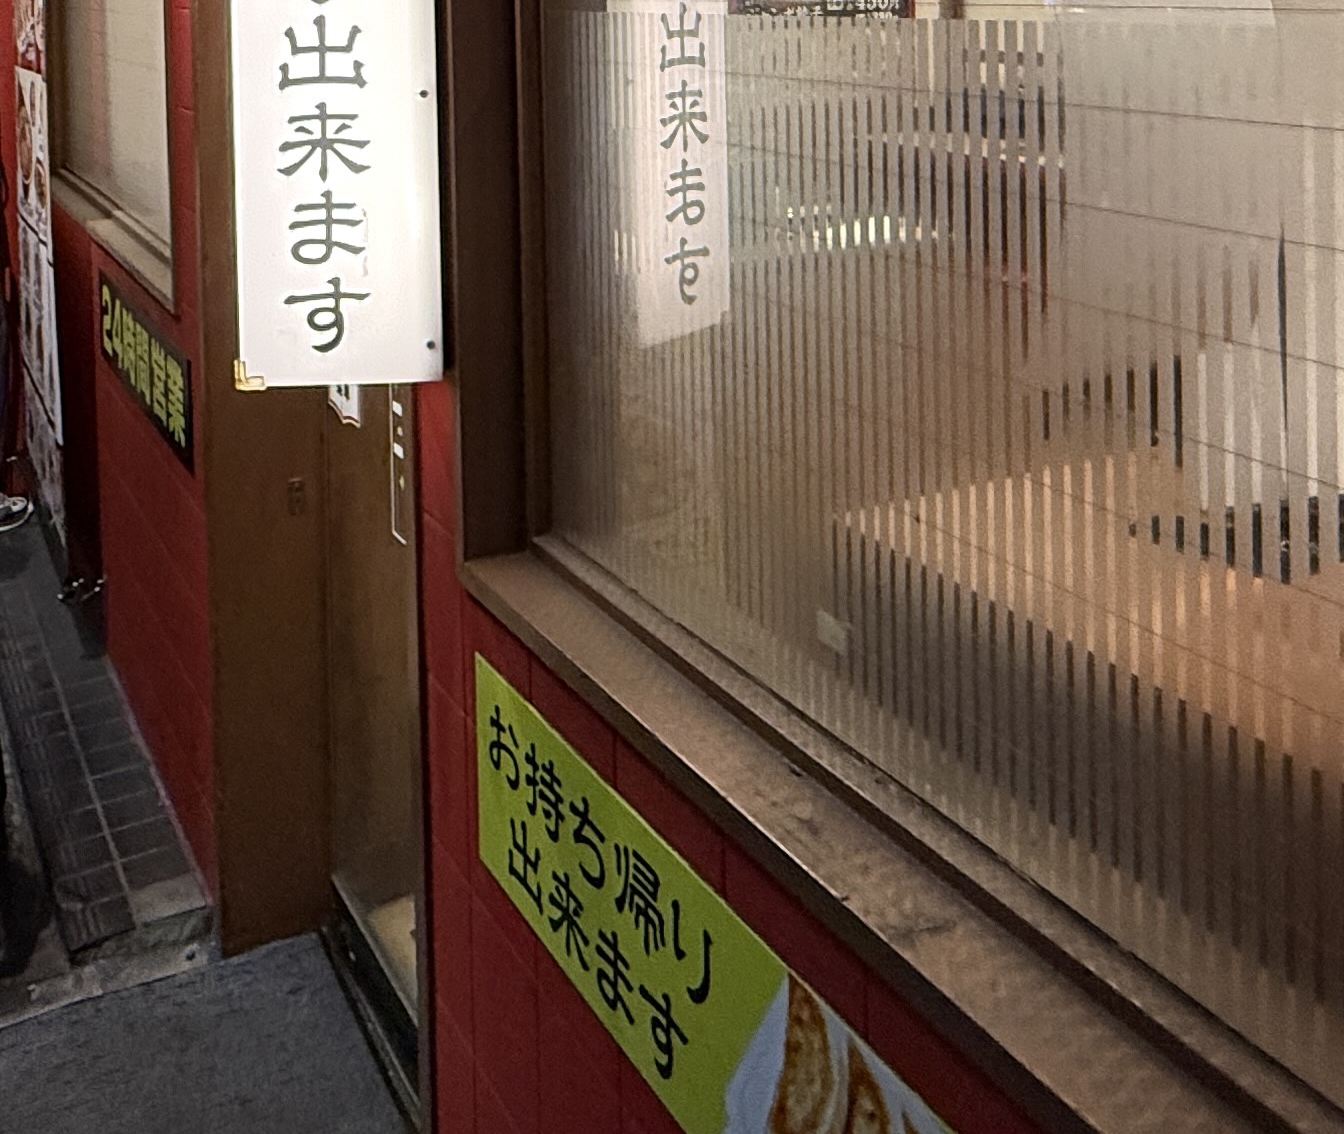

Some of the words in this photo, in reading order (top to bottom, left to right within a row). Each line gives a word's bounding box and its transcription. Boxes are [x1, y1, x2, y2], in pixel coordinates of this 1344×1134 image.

[102, 284, 187, 448] 24時間営業
[488, 704, 713, 1005] お持ち帰り
[508, 818, 689, 1081] 出来ます
